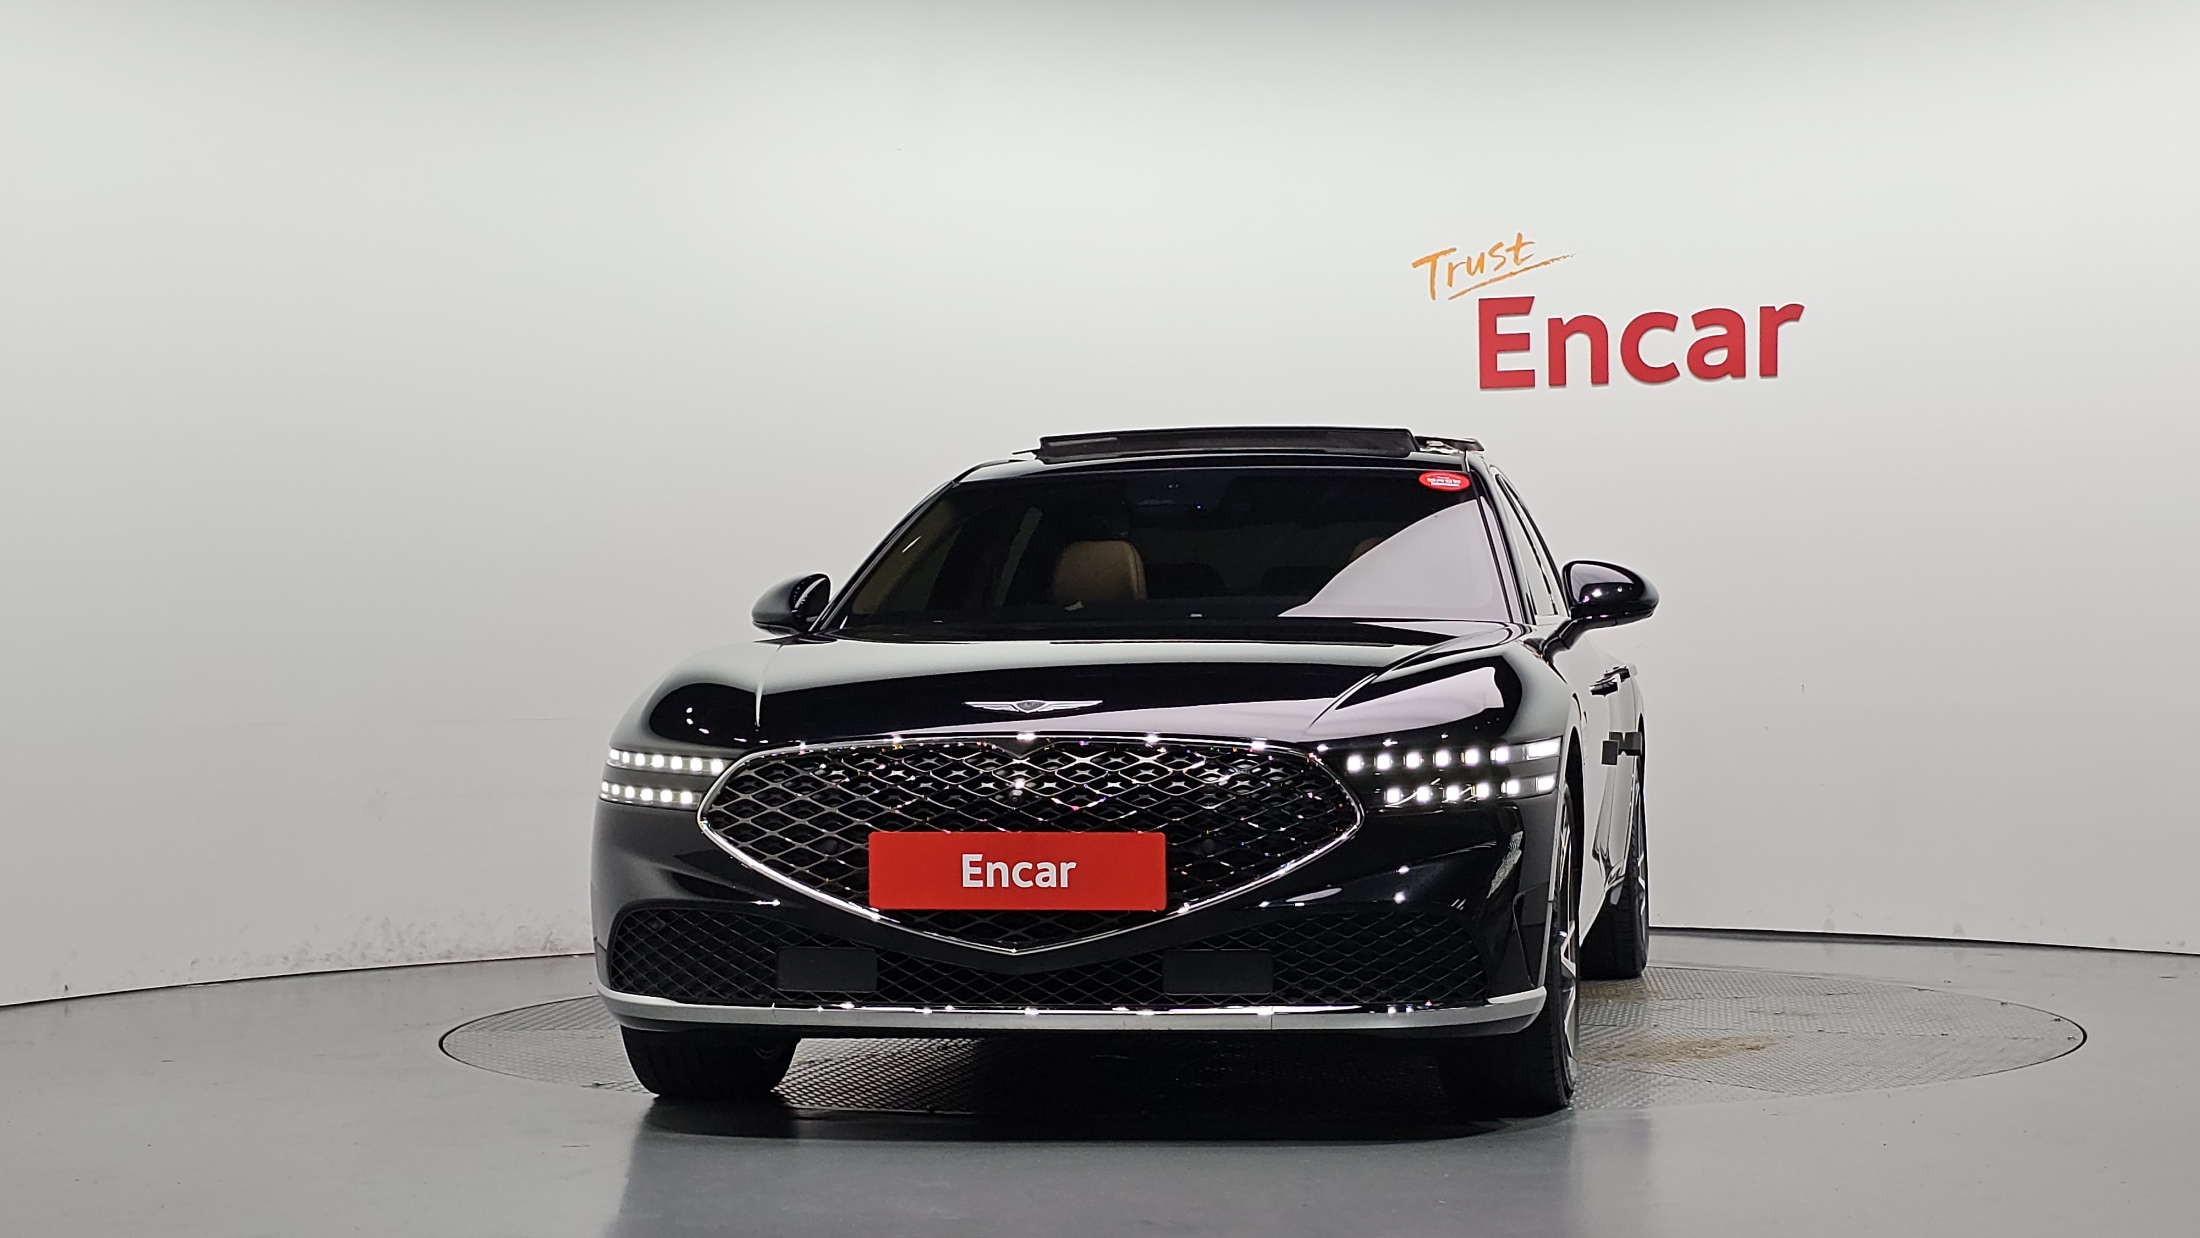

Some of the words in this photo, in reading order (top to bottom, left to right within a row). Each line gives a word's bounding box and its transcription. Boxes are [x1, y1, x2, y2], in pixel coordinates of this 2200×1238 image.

[1411, 232, 1536, 300] Trust
[1478, 296, 1804, 389] Encar
[961, 853, 1077, 888] Encar
